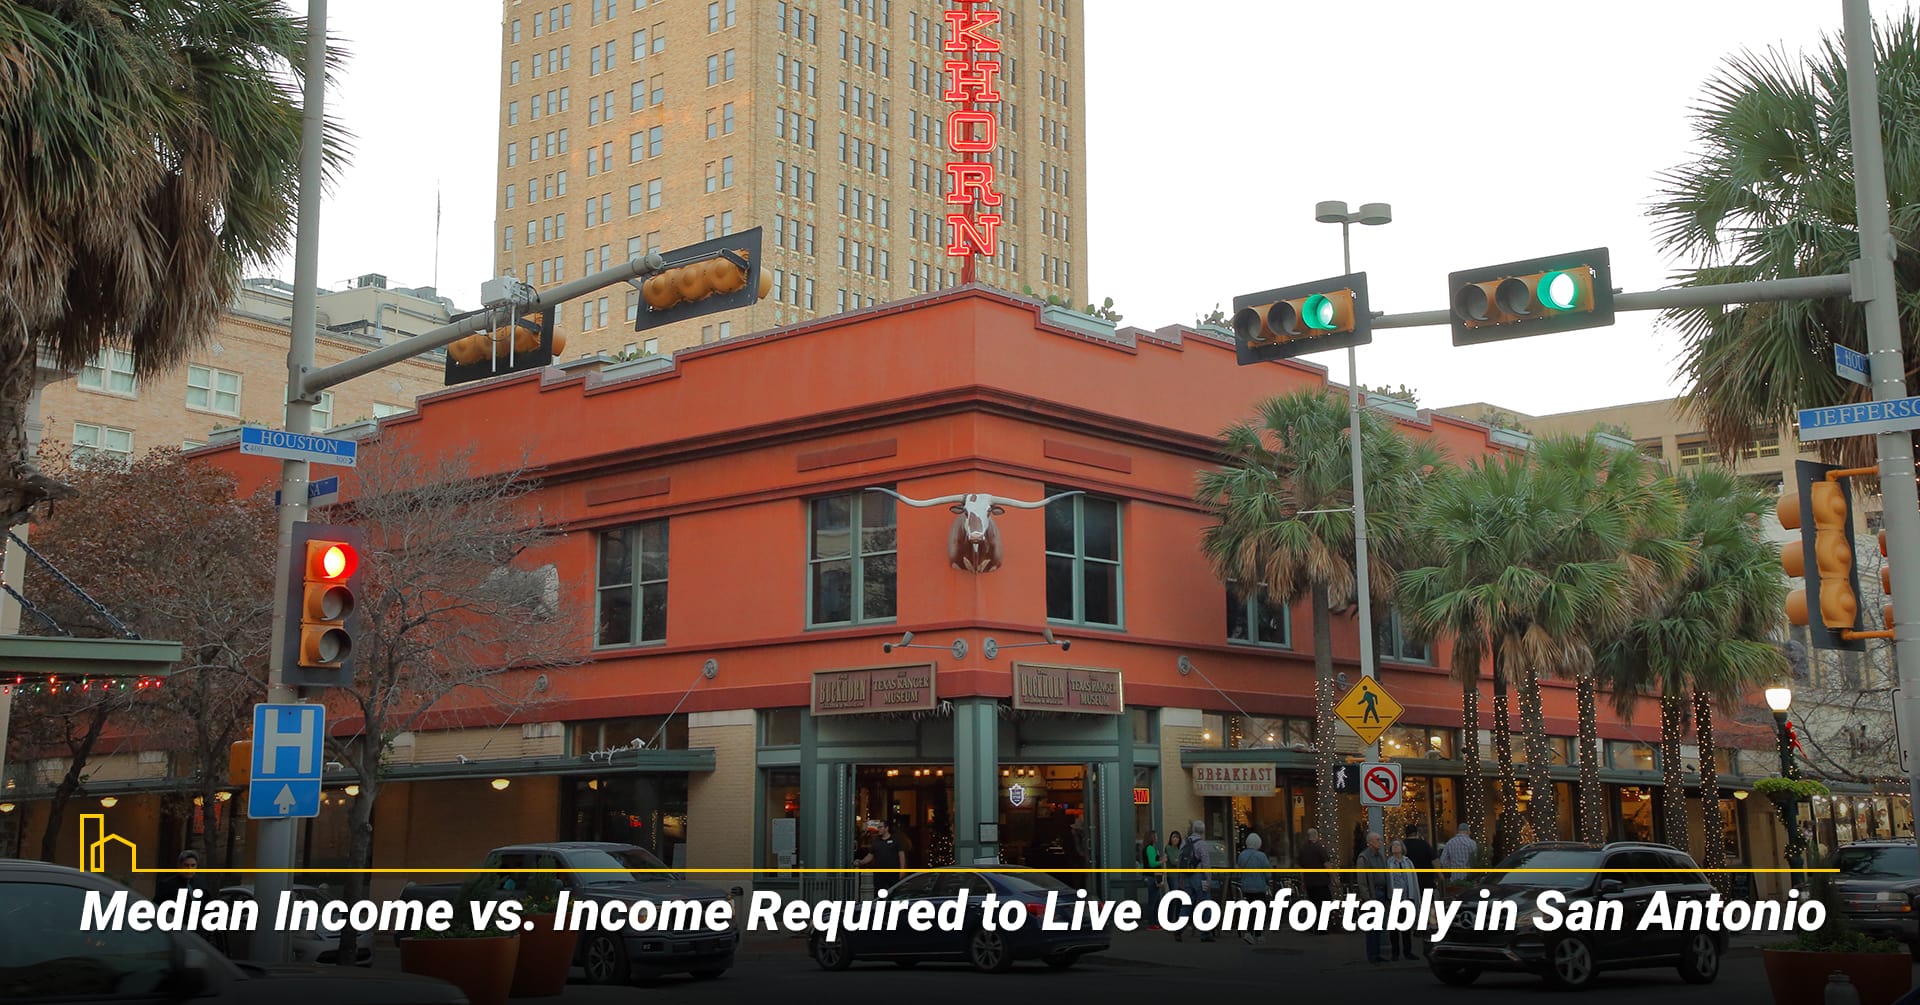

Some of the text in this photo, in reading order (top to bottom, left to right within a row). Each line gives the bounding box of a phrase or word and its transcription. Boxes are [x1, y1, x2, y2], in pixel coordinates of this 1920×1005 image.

[944, 0, 1003, 256] KHORN
[260, 430, 338, 453] HOUSTON
[820, 679, 866, 703] BUCKHORN
[873, 675, 929, 691] TEXAS RANGER
[1070, 679, 1091, 692] TEXAS
[884, 690, 919, 704] MUSEUM
[262, 709, 315, 774] H
[1197, 768, 1272, 781] BREAKFAST
